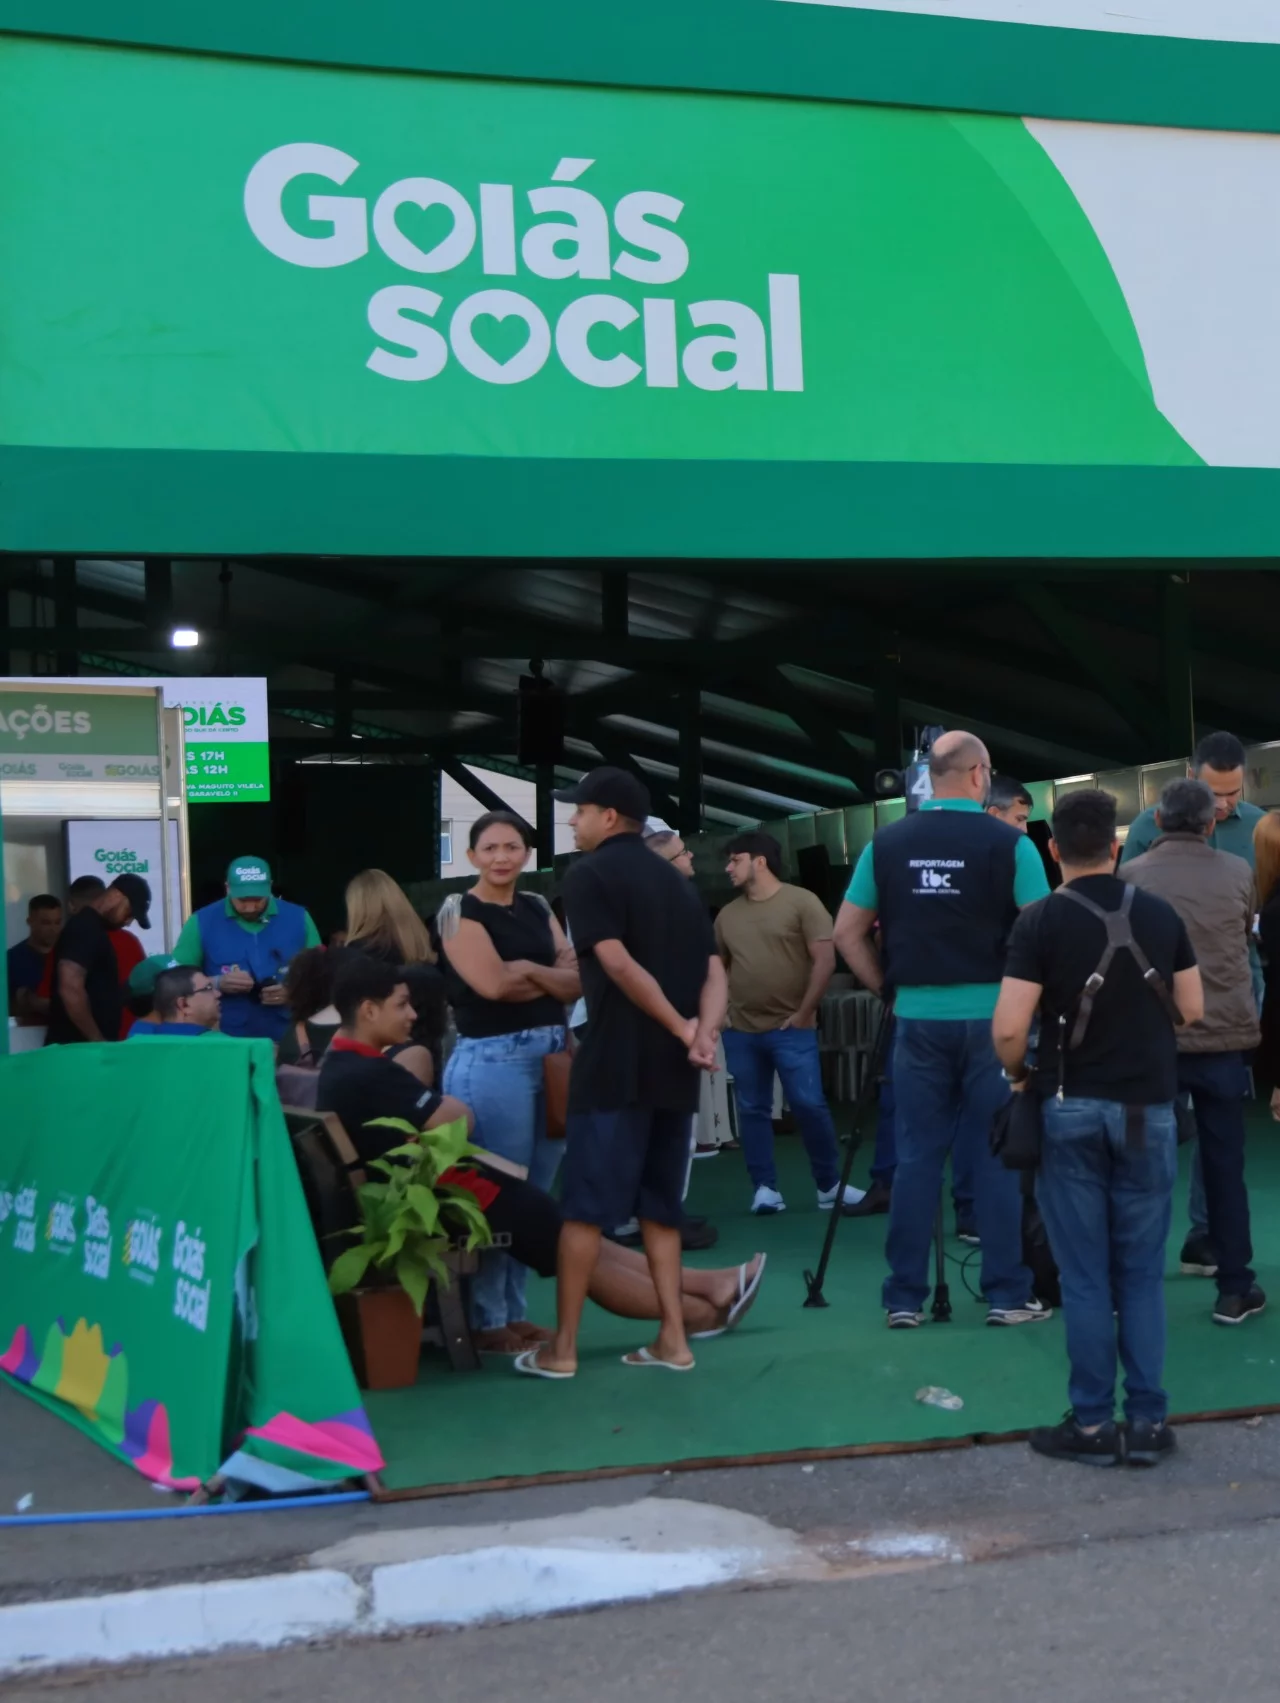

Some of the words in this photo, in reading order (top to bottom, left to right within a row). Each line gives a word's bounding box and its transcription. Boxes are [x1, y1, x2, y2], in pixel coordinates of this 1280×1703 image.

[244, 142, 689, 284] Goiás
[365, 273, 804, 392] social
[183, 702, 246, 726] OIÁS
[200, 751, 225, 761] 17H
[0, 760, 36, 775] OIÁS
[203, 765, 228, 774] 12H
[106, 860, 148, 873] social
[909, 859, 965, 869] REPORTAGEM
[920, 869, 952, 887] tbc
